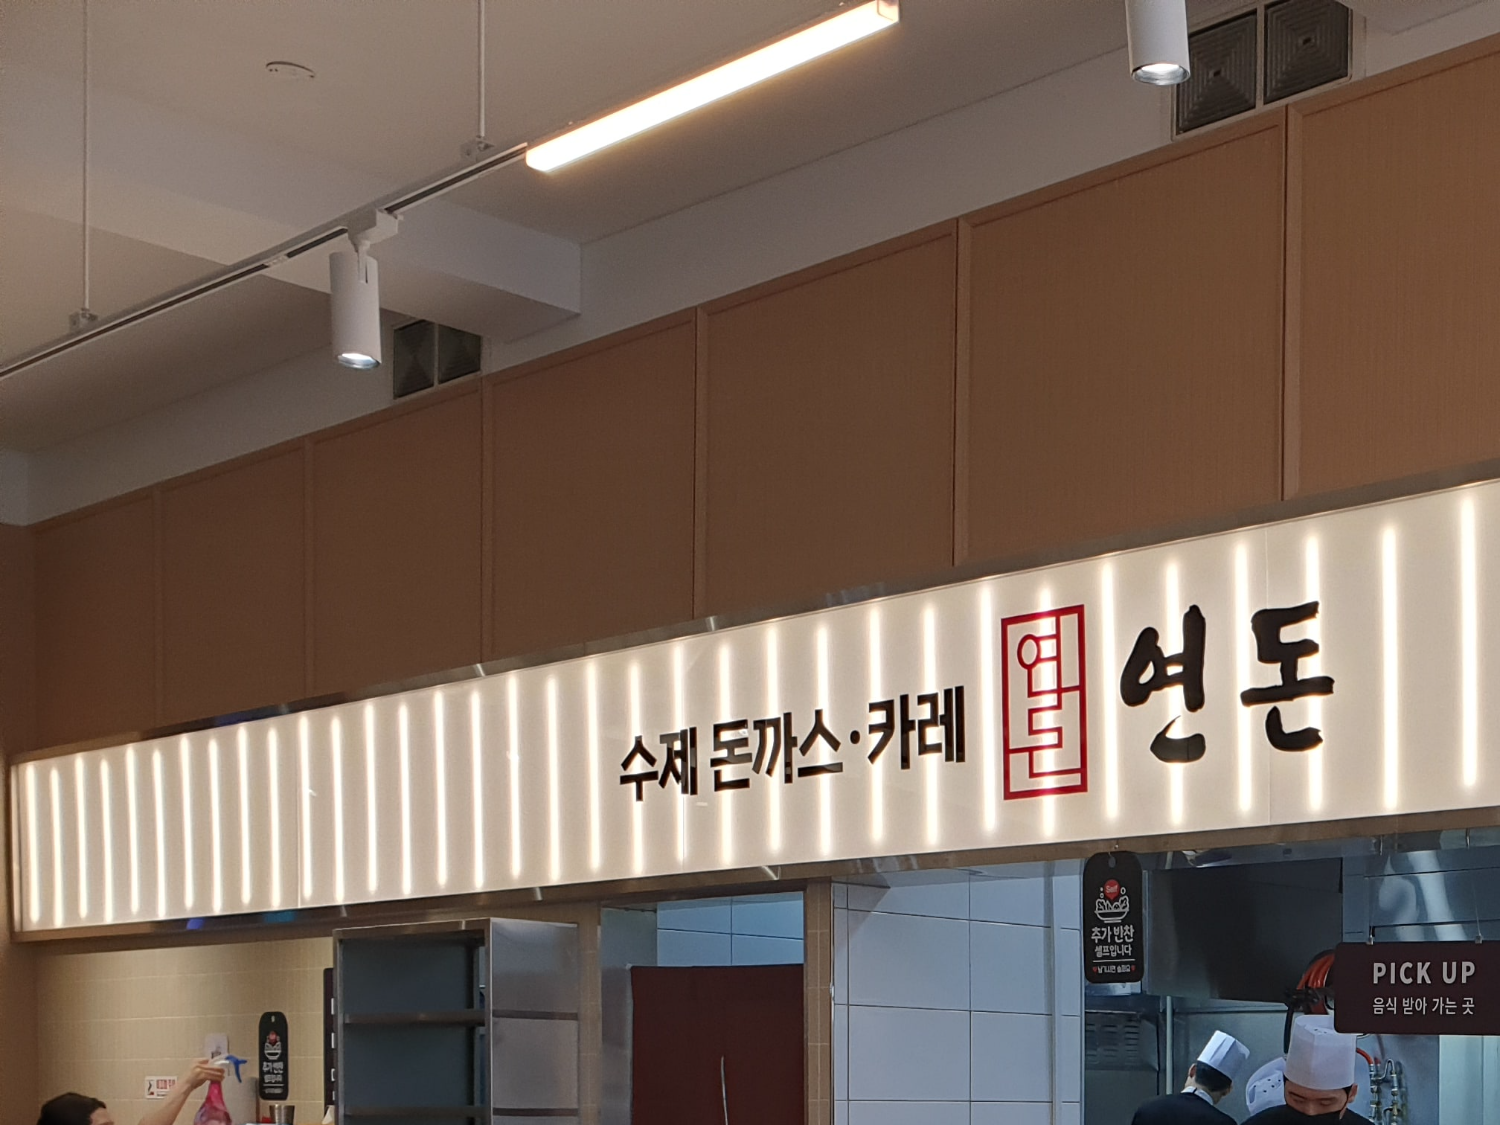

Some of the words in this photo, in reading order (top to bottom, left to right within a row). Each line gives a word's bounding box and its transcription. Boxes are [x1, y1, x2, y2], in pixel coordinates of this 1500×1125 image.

[1120, 601, 1335, 763] 연돈
[620, 726, 698, 801] 수제
[710, 685, 966, 792] 돈까스·카레
[1091, 926, 1112, 943] 추가
[1113, 924, 1135, 943] 반찬
[1094, 944, 1132, 958] 셀프입니다
[1373, 962, 1431, 985] PICK
[1442, 961, 1476, 984] UP
[1372, 997, 1397, 1015] 음식
[1402, 997, 1427, 1015] 받아
[1432, 997, 1457, 1015] 가는
[1461, 997, 1475, 1015] 곳
